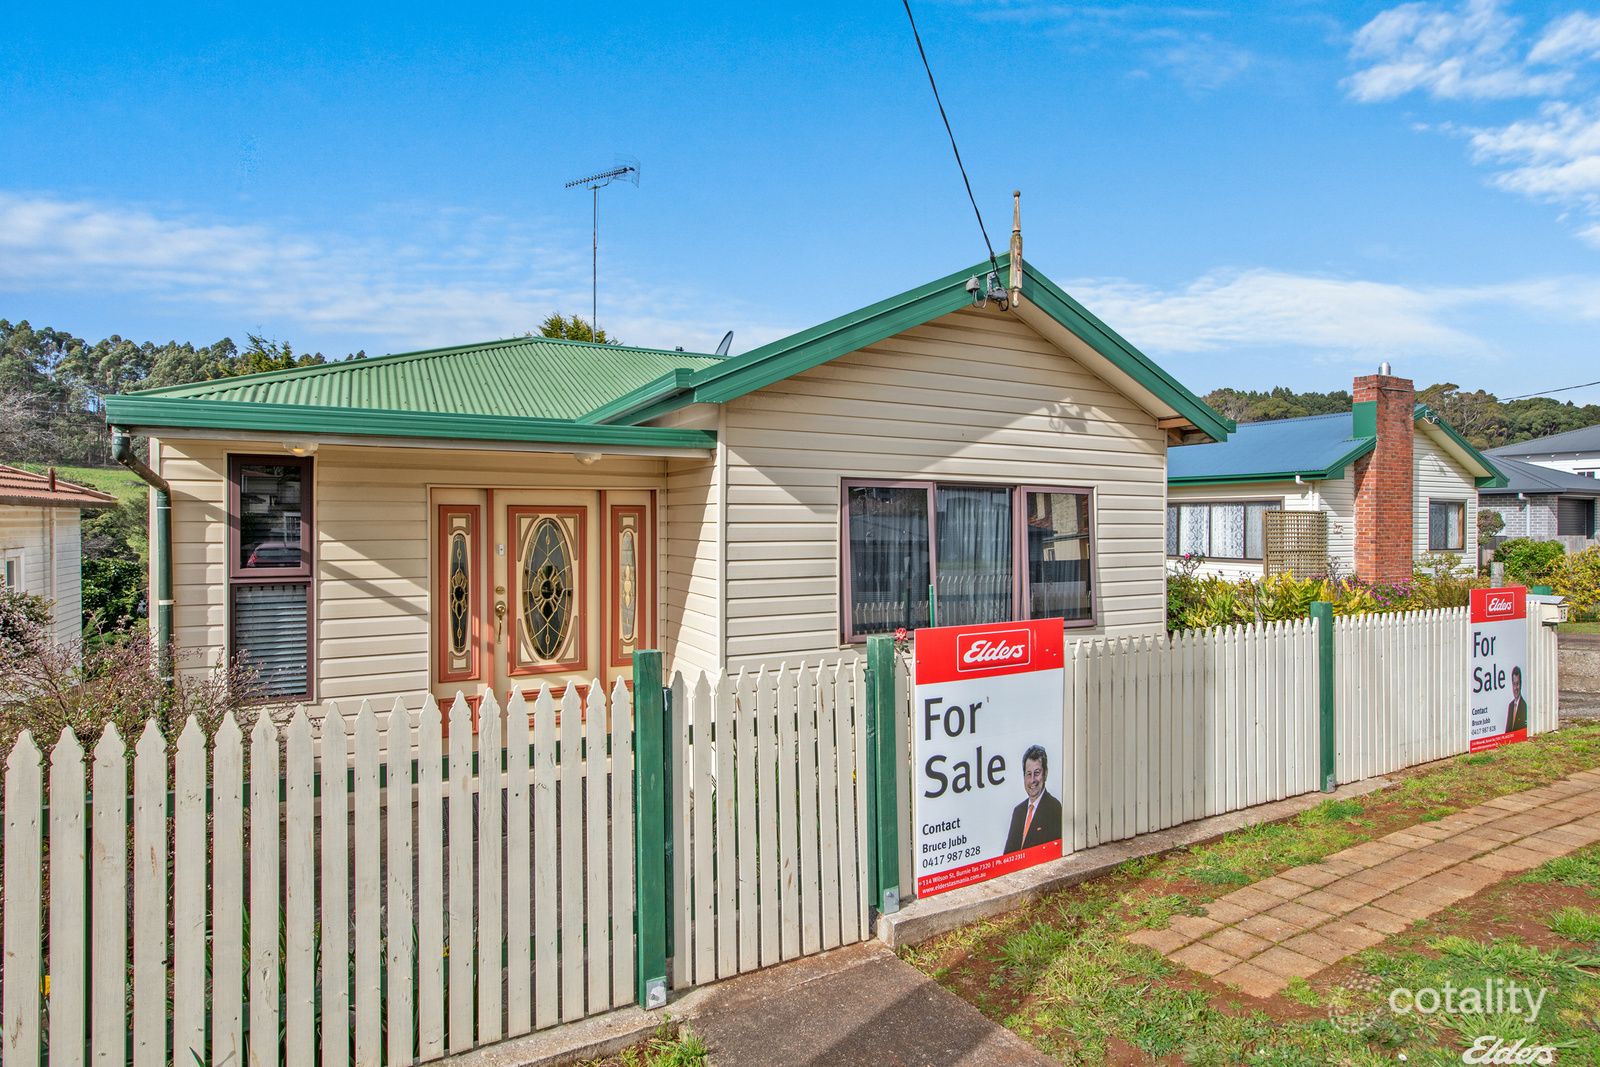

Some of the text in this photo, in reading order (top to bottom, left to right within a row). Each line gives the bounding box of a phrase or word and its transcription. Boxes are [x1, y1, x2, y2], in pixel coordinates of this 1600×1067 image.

[1488, 597, 1512, 612] Elders
[963, 639, 1025, 664] Elders
[1473, 631, 1496, 658] For
[1473, 663, 1506, 693] Sale
[924, 697, 983, 741] For
[924, 745, 1006, 799] Sale
[922, 817, 961, 836] Contact
[922, 834, 967, 854] Bruce Jubb
[922, 846, 981, 869] 0417 987 828
